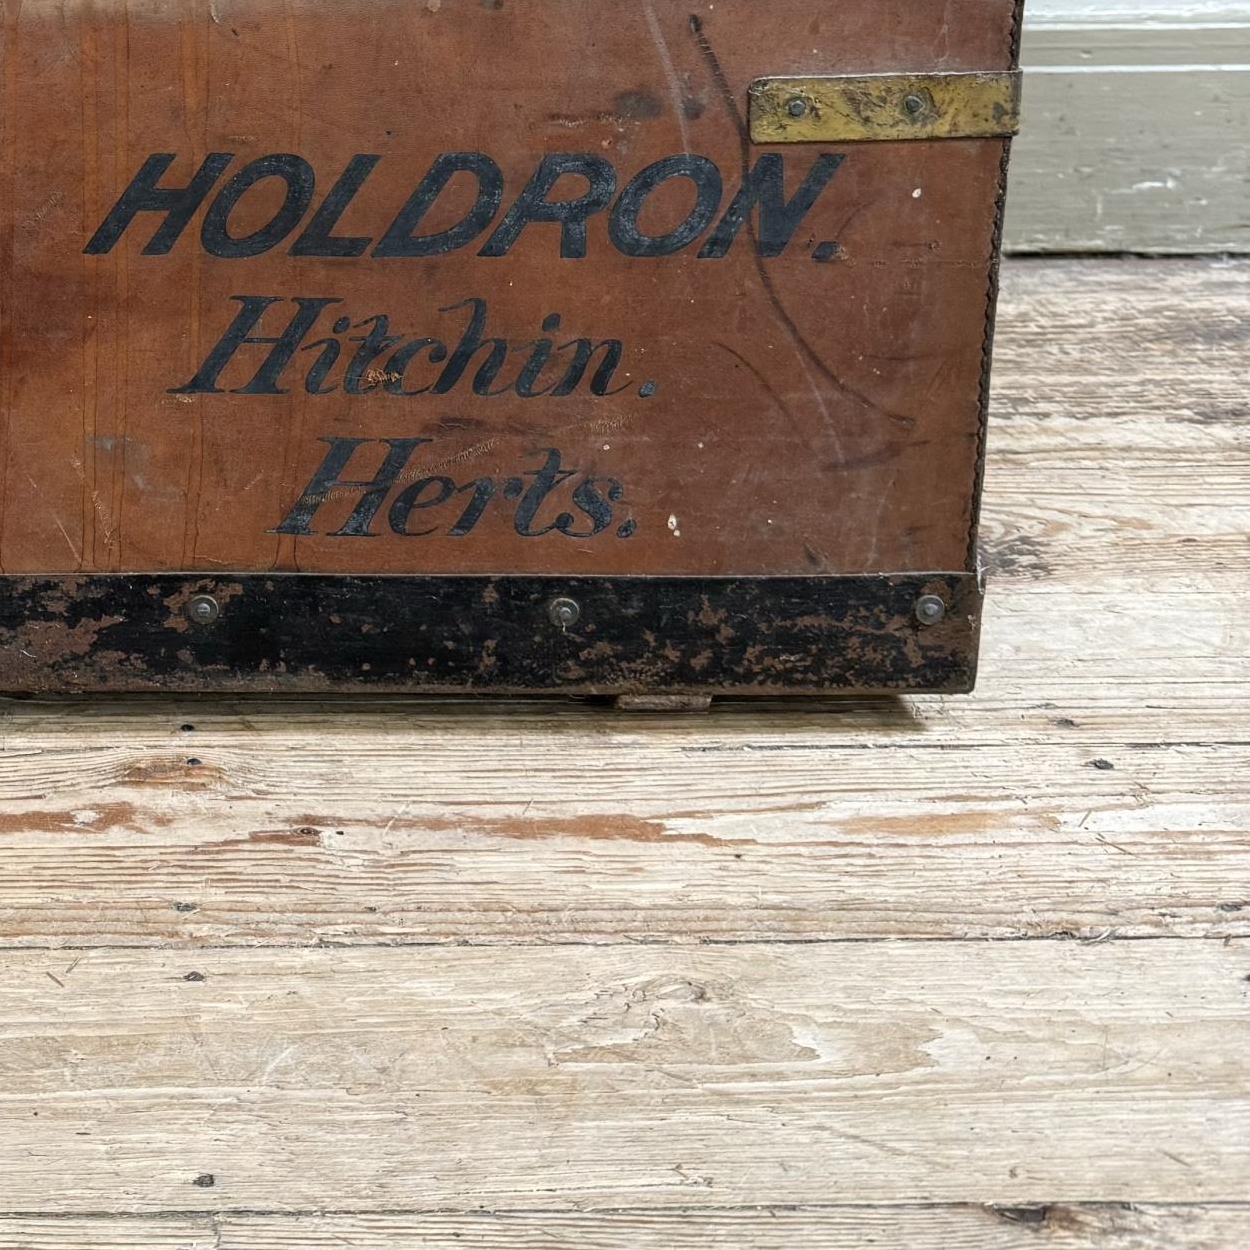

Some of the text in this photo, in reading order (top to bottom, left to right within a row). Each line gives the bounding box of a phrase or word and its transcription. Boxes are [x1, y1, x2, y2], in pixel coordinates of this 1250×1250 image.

[82, 152, 847, 260] HOLDRON.
[165, 295, 659, 399] Hitchin.
[265, 435, 639, 538] Herts.
